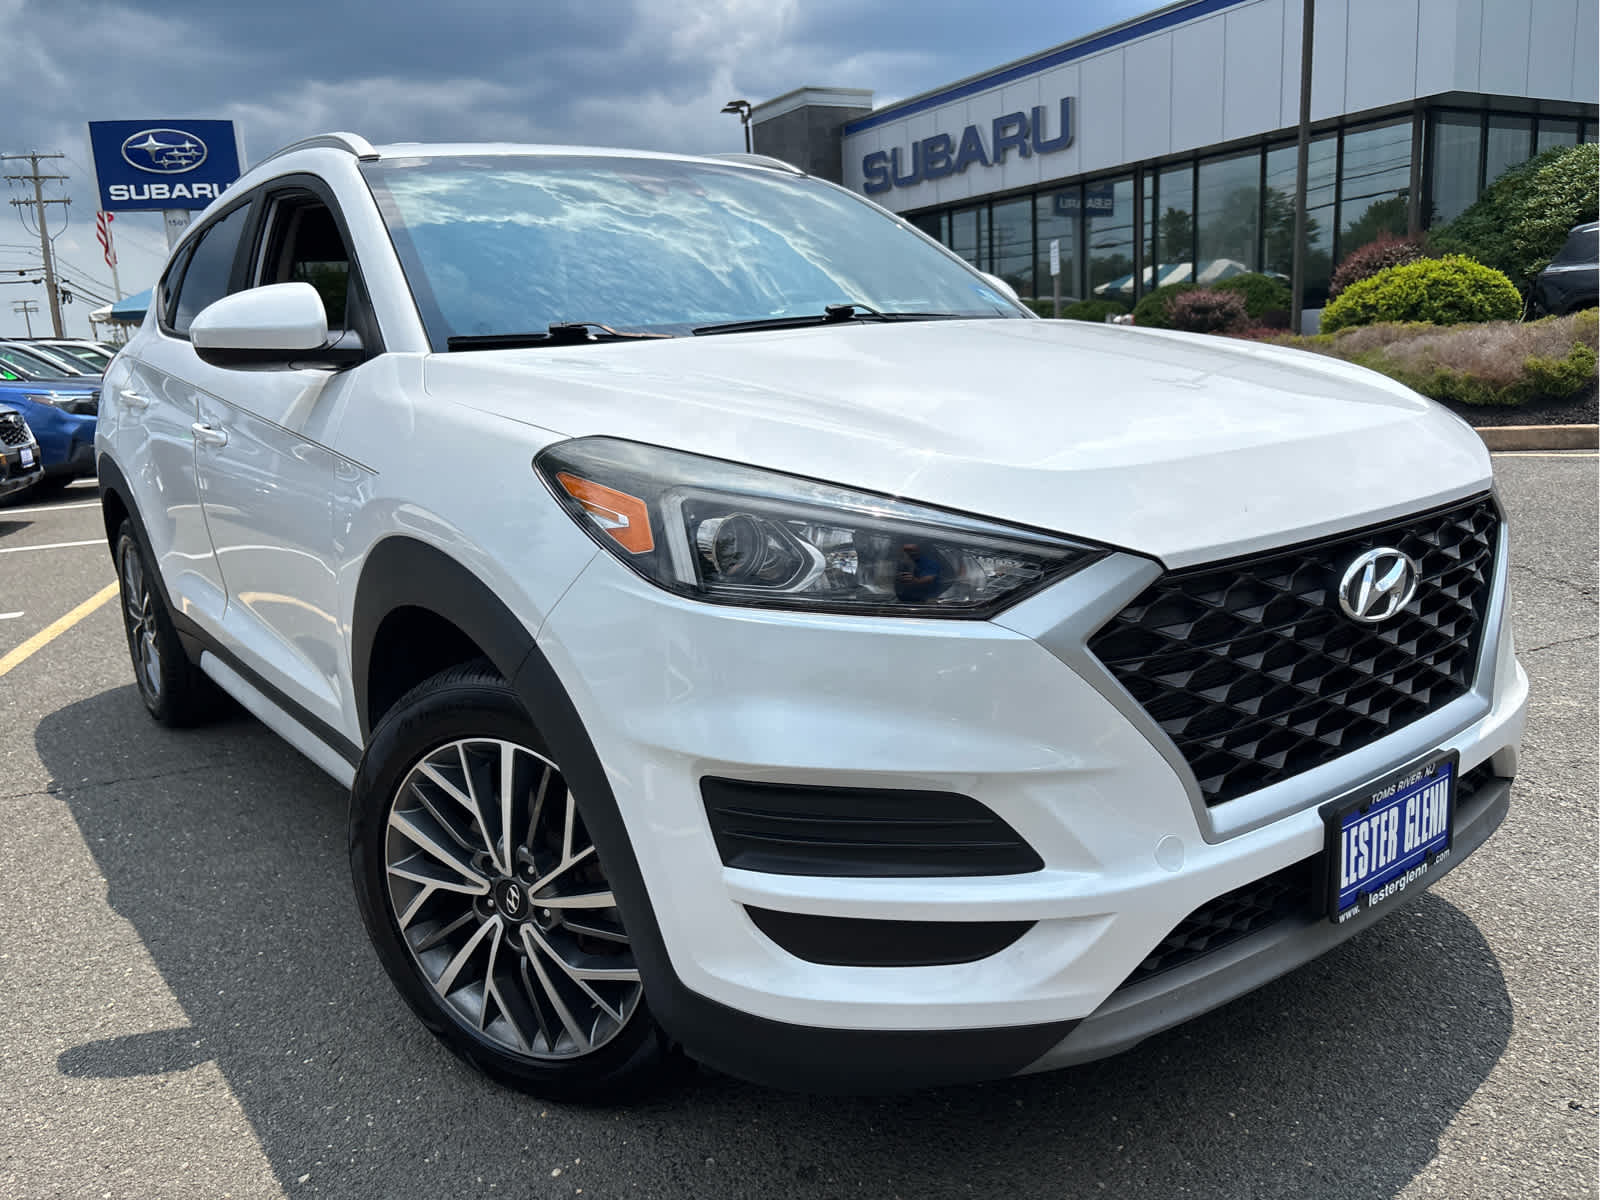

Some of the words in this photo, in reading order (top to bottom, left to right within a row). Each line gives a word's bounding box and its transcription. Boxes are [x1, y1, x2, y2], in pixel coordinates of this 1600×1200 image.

[862, 96, 1076, 196] SUBARU
[1371, 784, 1396, 804] TOMS
[1424, 764, 1436, 777] NJ
[1340, 806, 1399, 889] LESTER
[1404, 778, 1449, 853] GLENN
[1338, 904, 1360, 923] www.
[1368, 862, 1428, 907] lesterglenn
[1433, 849, 1450, 866] .com
